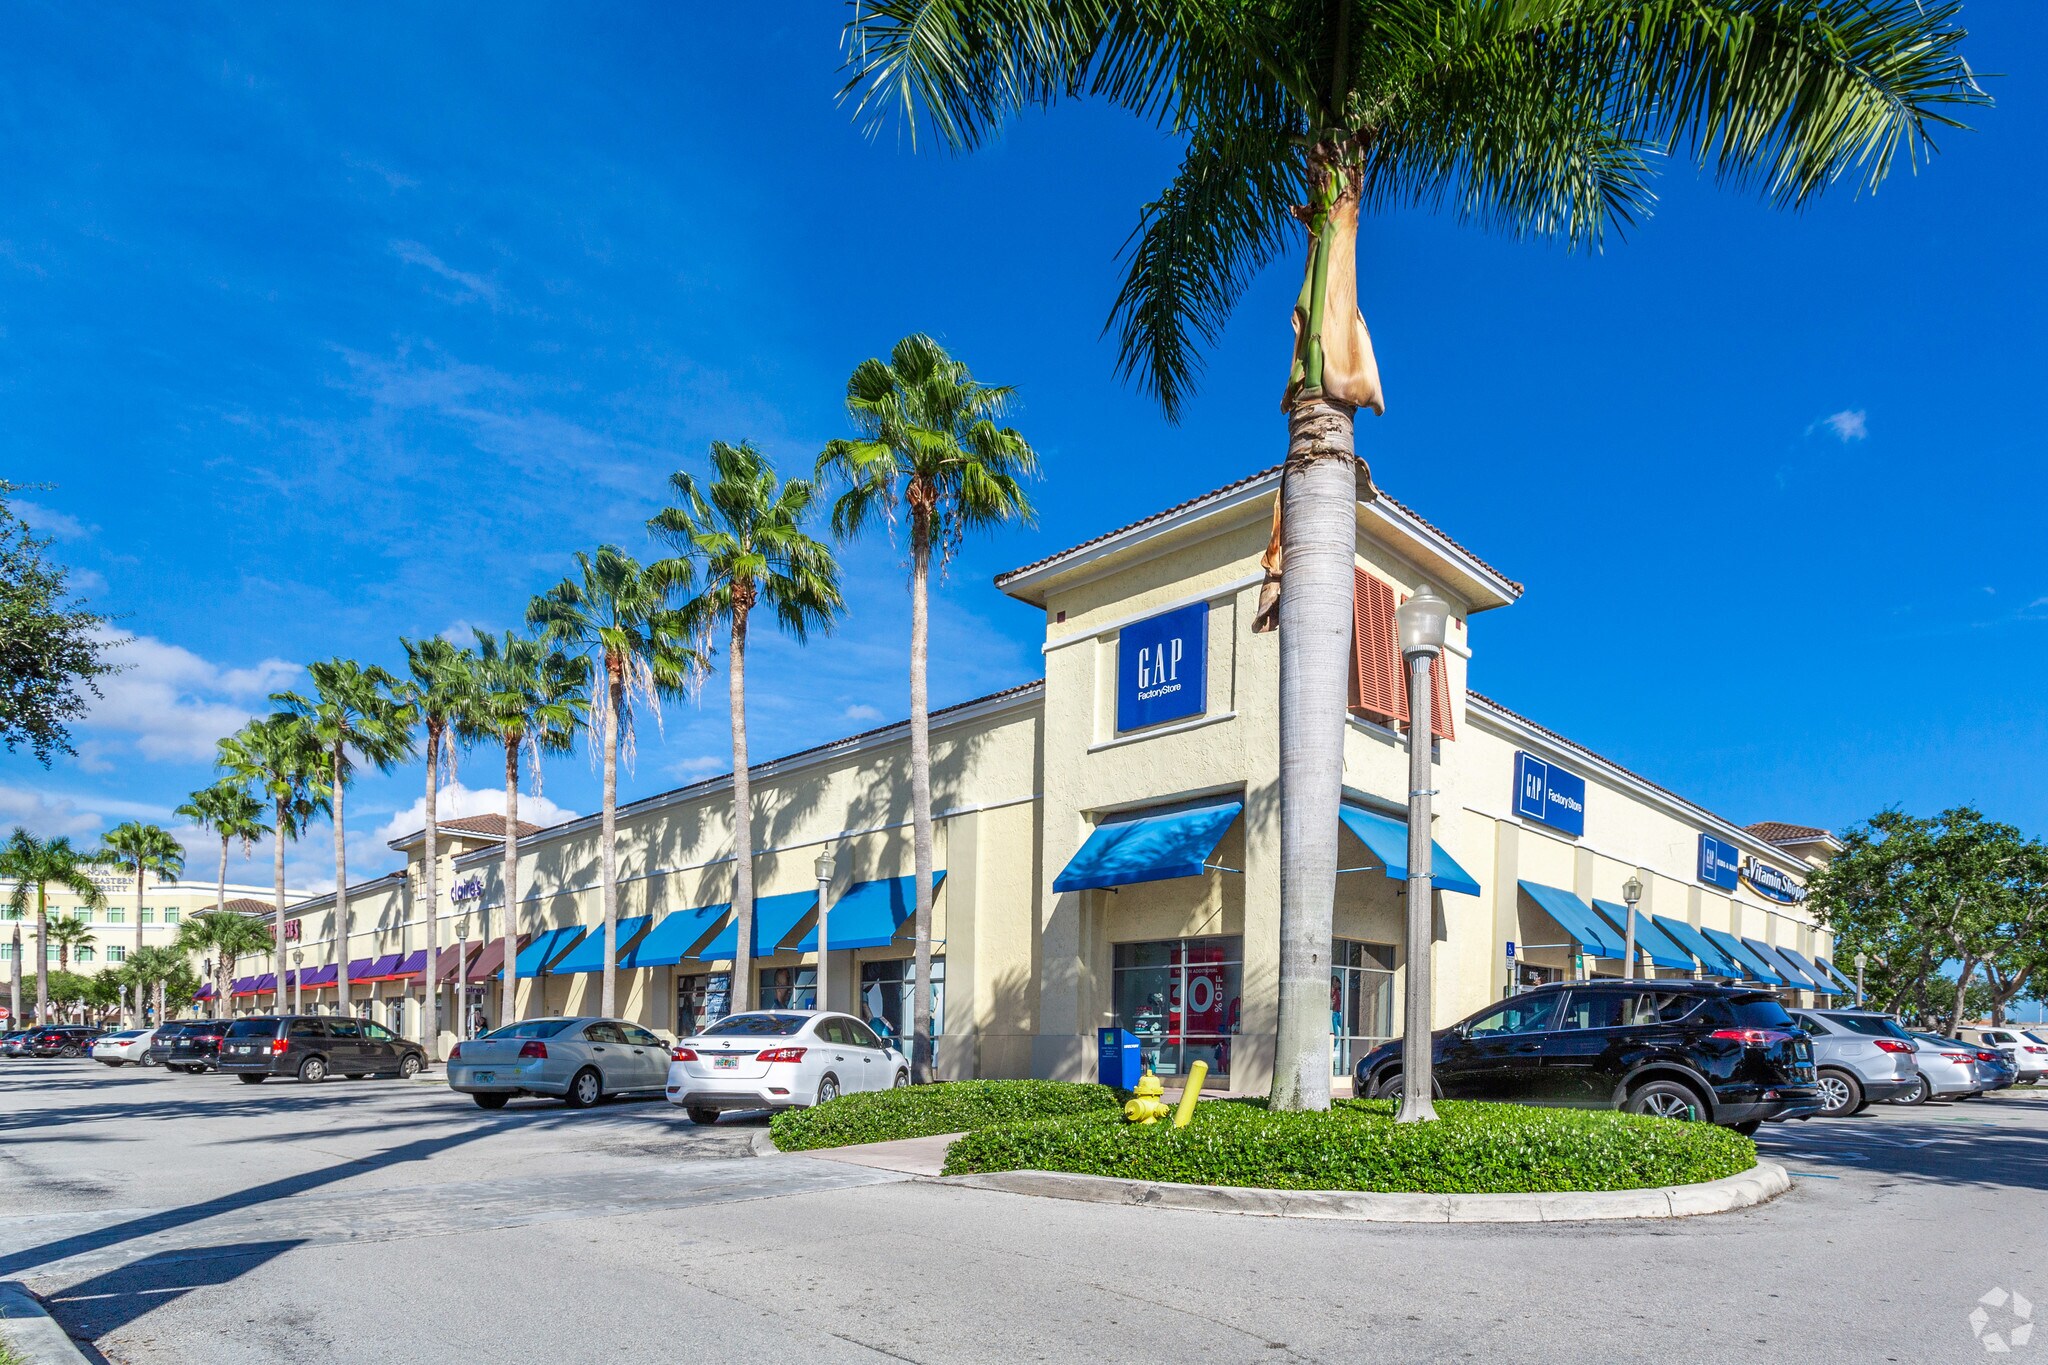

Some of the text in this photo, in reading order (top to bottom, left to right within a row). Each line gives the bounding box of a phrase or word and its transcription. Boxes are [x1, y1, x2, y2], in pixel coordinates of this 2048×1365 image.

[1138, 638, 1183, 688] GAP
[1526, 773, 1542, 801] GAP
[1749, 856, 1782, 891] Vitamin
